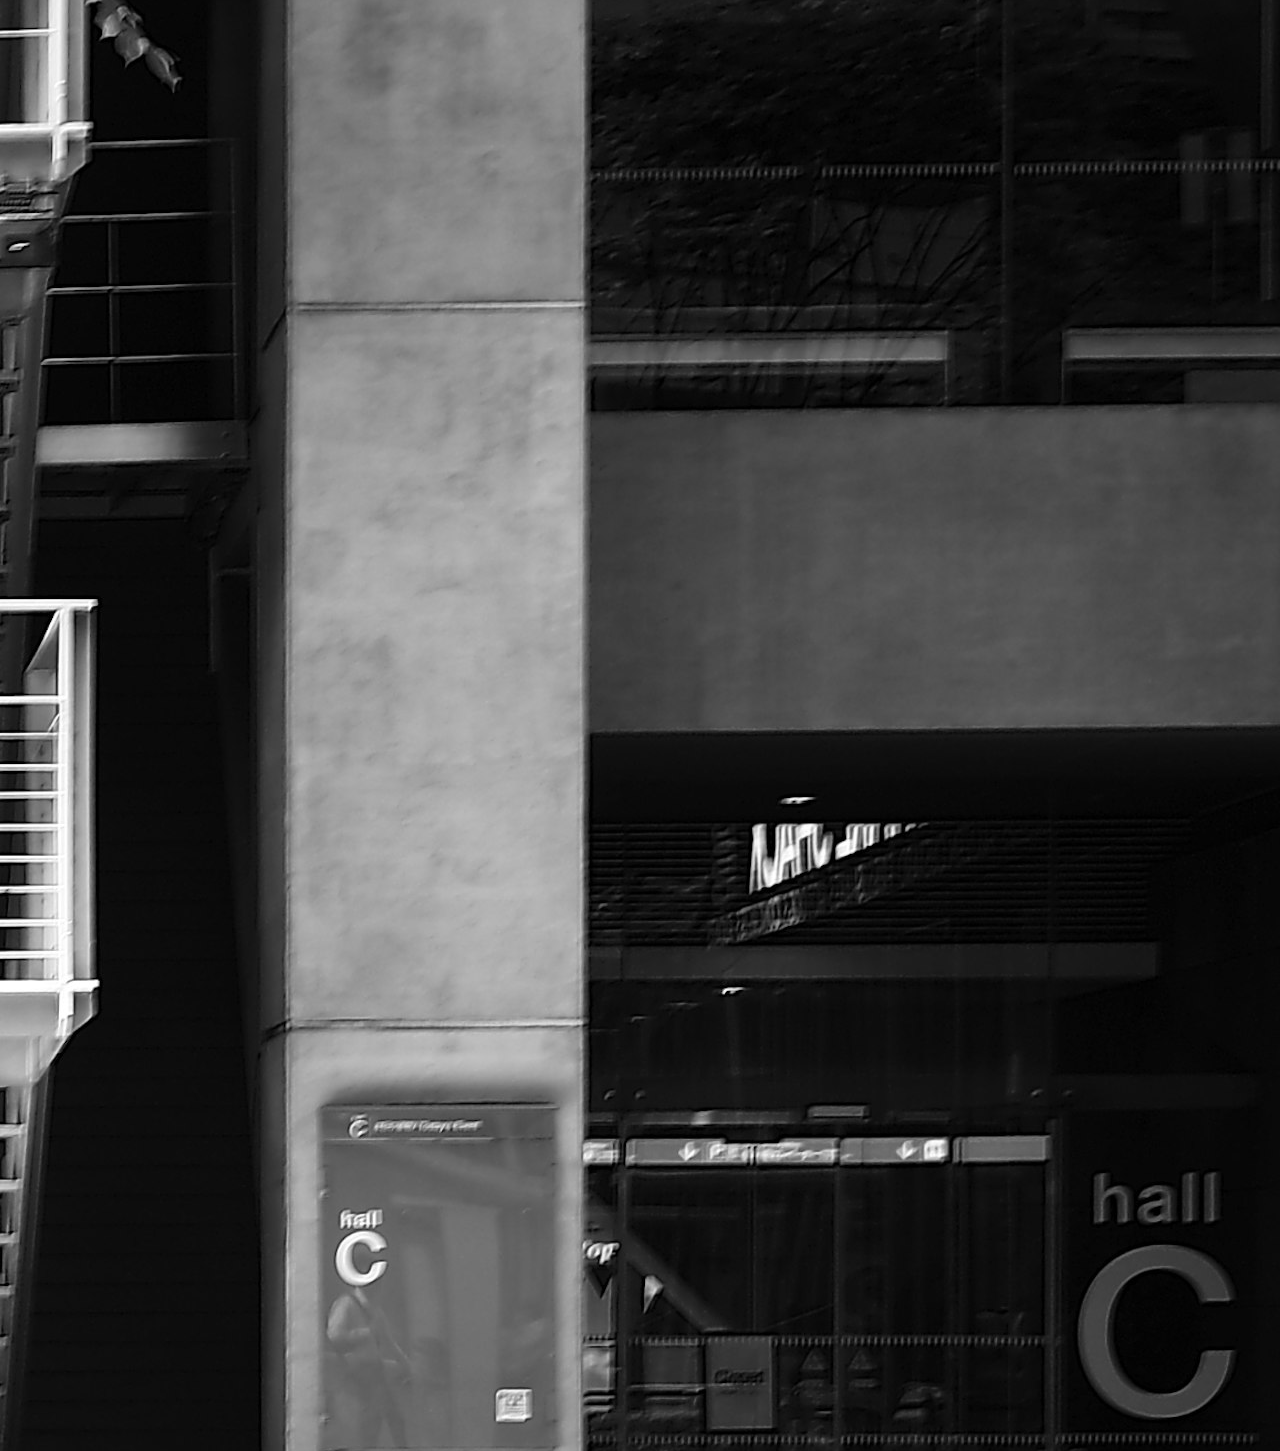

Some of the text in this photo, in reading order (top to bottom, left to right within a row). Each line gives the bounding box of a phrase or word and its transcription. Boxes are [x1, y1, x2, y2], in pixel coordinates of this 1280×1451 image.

[340, 1209, 383, 1229] hall
[1092, 1171, 1224, 1225] hall
[335, 1230, 388, 1287] C
[1077, 1244, 1238, 1419] C
